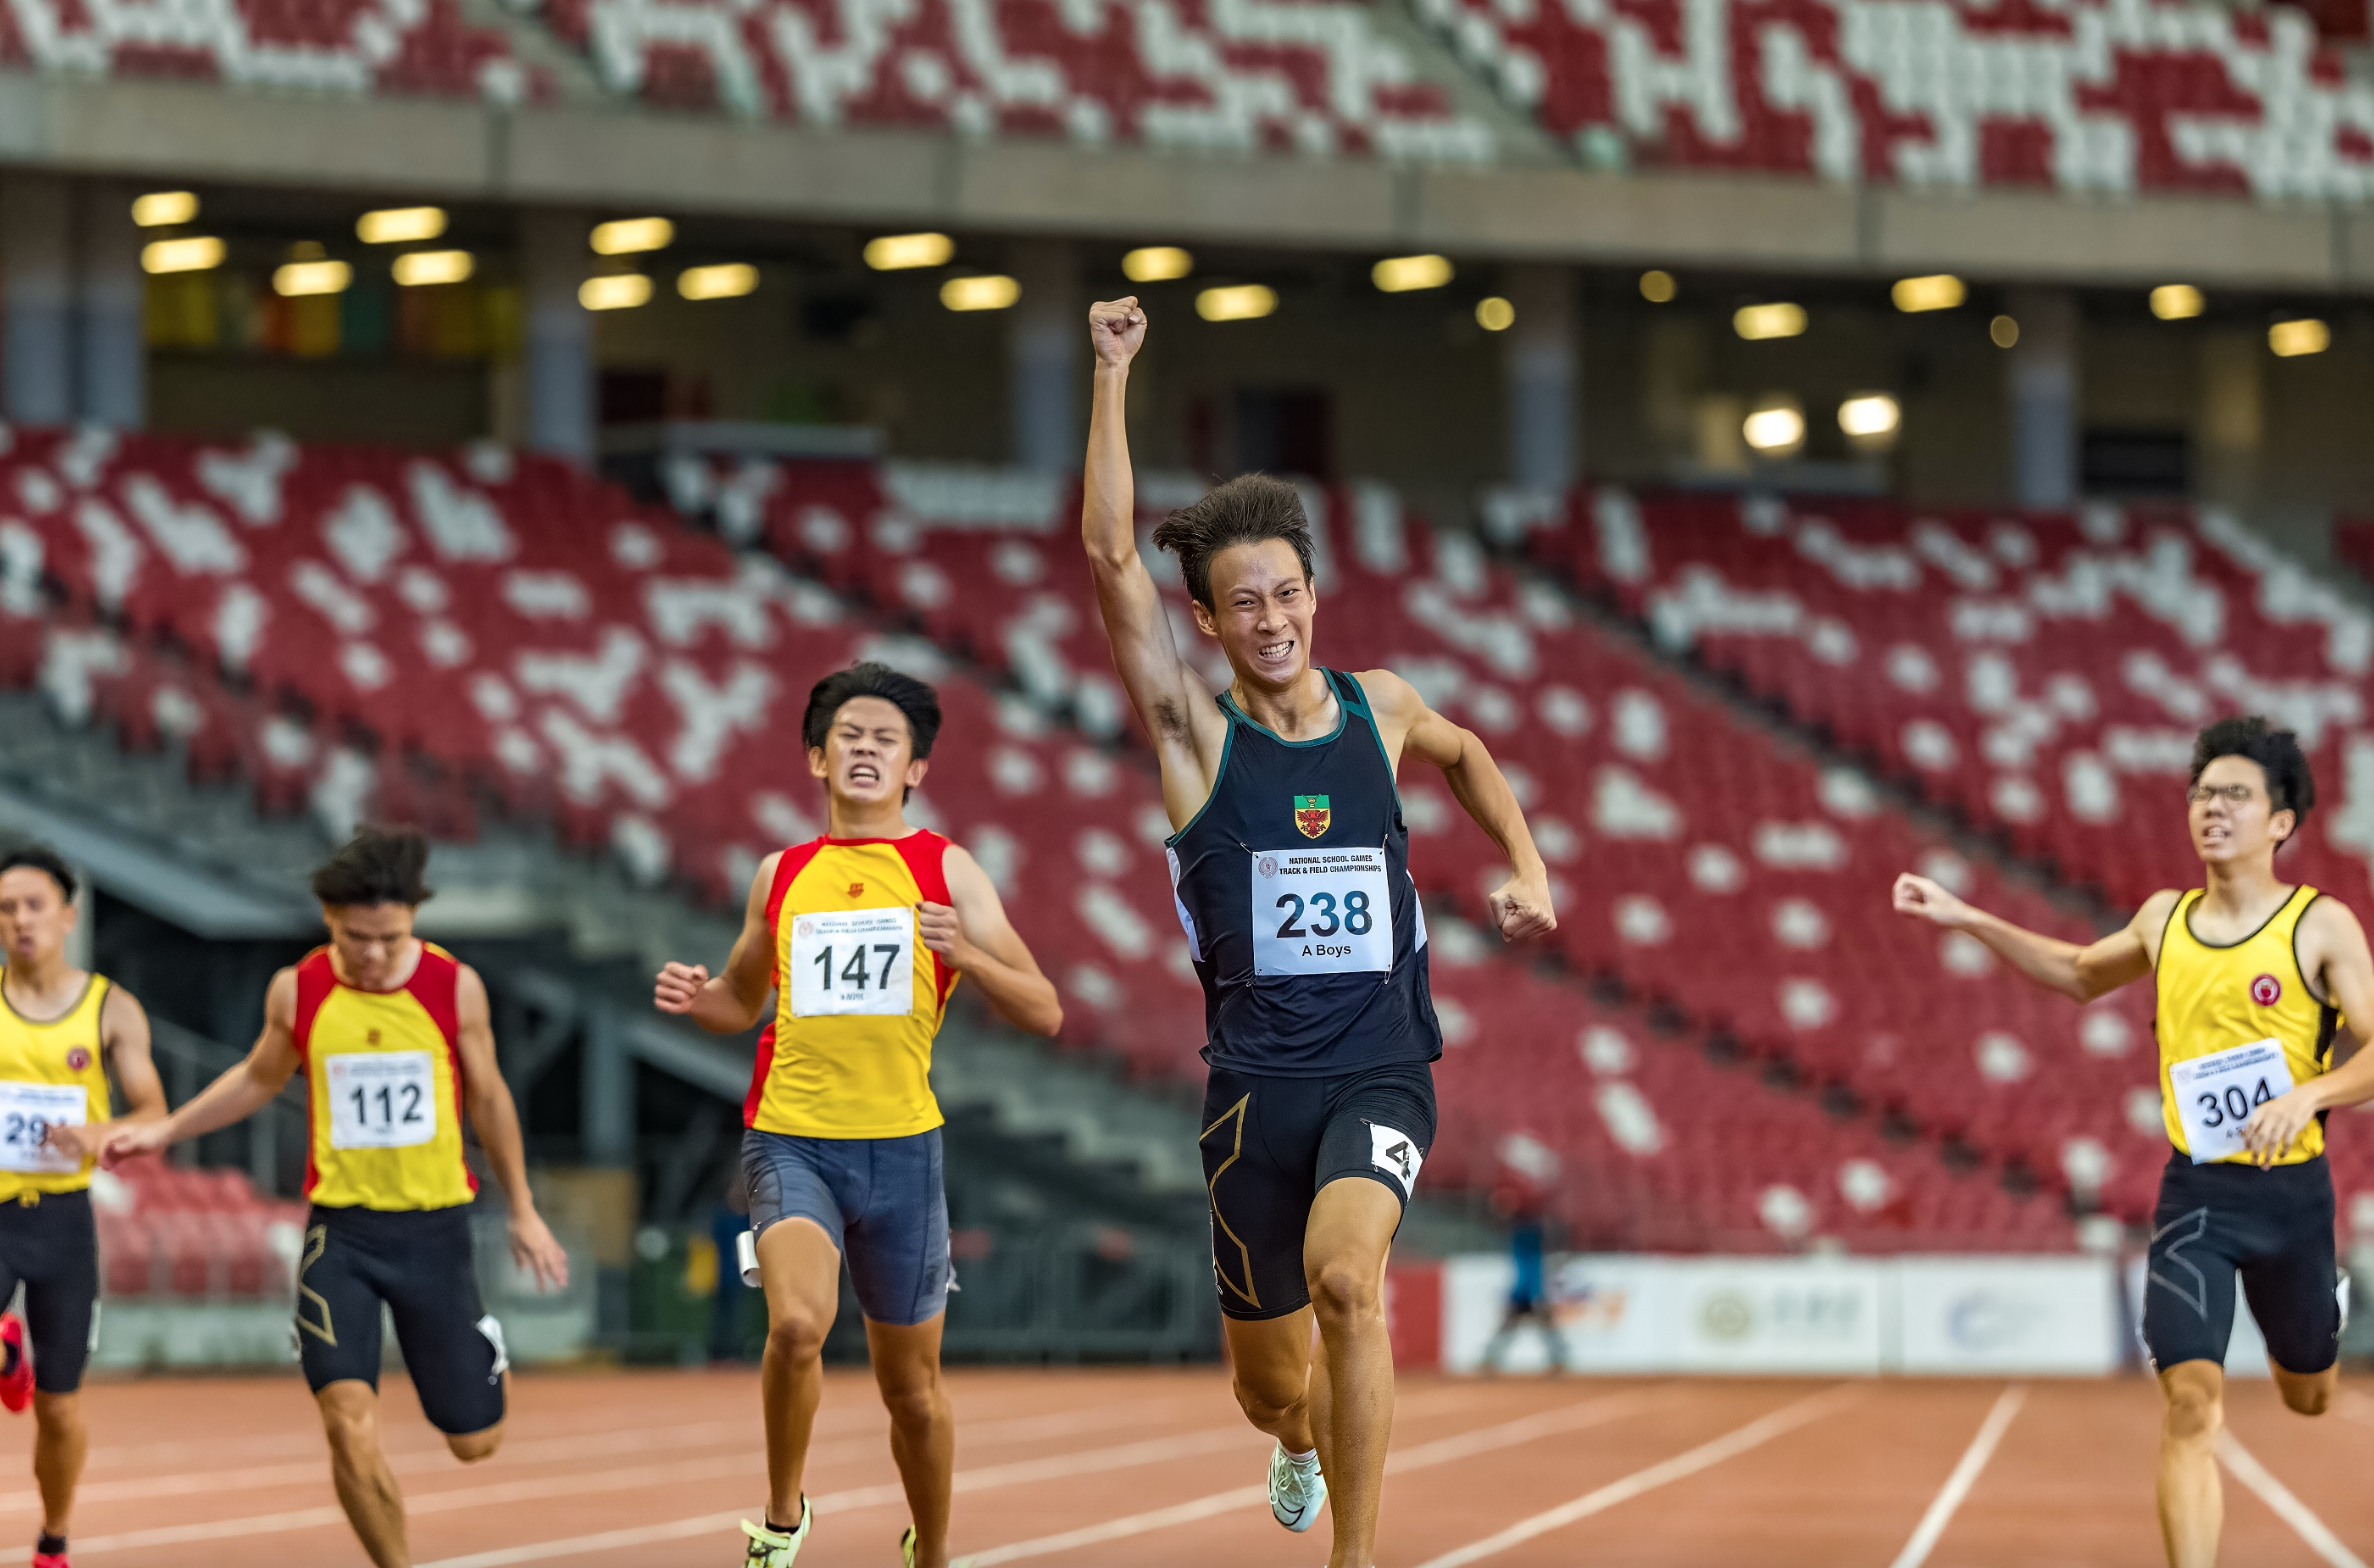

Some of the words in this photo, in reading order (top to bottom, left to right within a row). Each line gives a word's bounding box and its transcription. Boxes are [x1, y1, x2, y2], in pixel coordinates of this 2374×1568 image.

[1279, 867, 1301, 875] TRACK
[1309, 866, 1328, 874] FIELD
[1330, 865, 1382, 873] CHAMPIONSHIPS
[1289, 856, 1320, 865] NATIONAL
[1322, 855, 1349, 863] SCHOOL
[1351, 854, 1373, 862] GAMES
[1275, 890, 1373, 938] 238
[813, 944, 900, 991] 147
[1301, 945, 1312, 957] A
[1316, 944, 1352, 957] Boys
[350, 1082, 423, 1125] 112
[1385, 1140, 1411, 1180] 4
